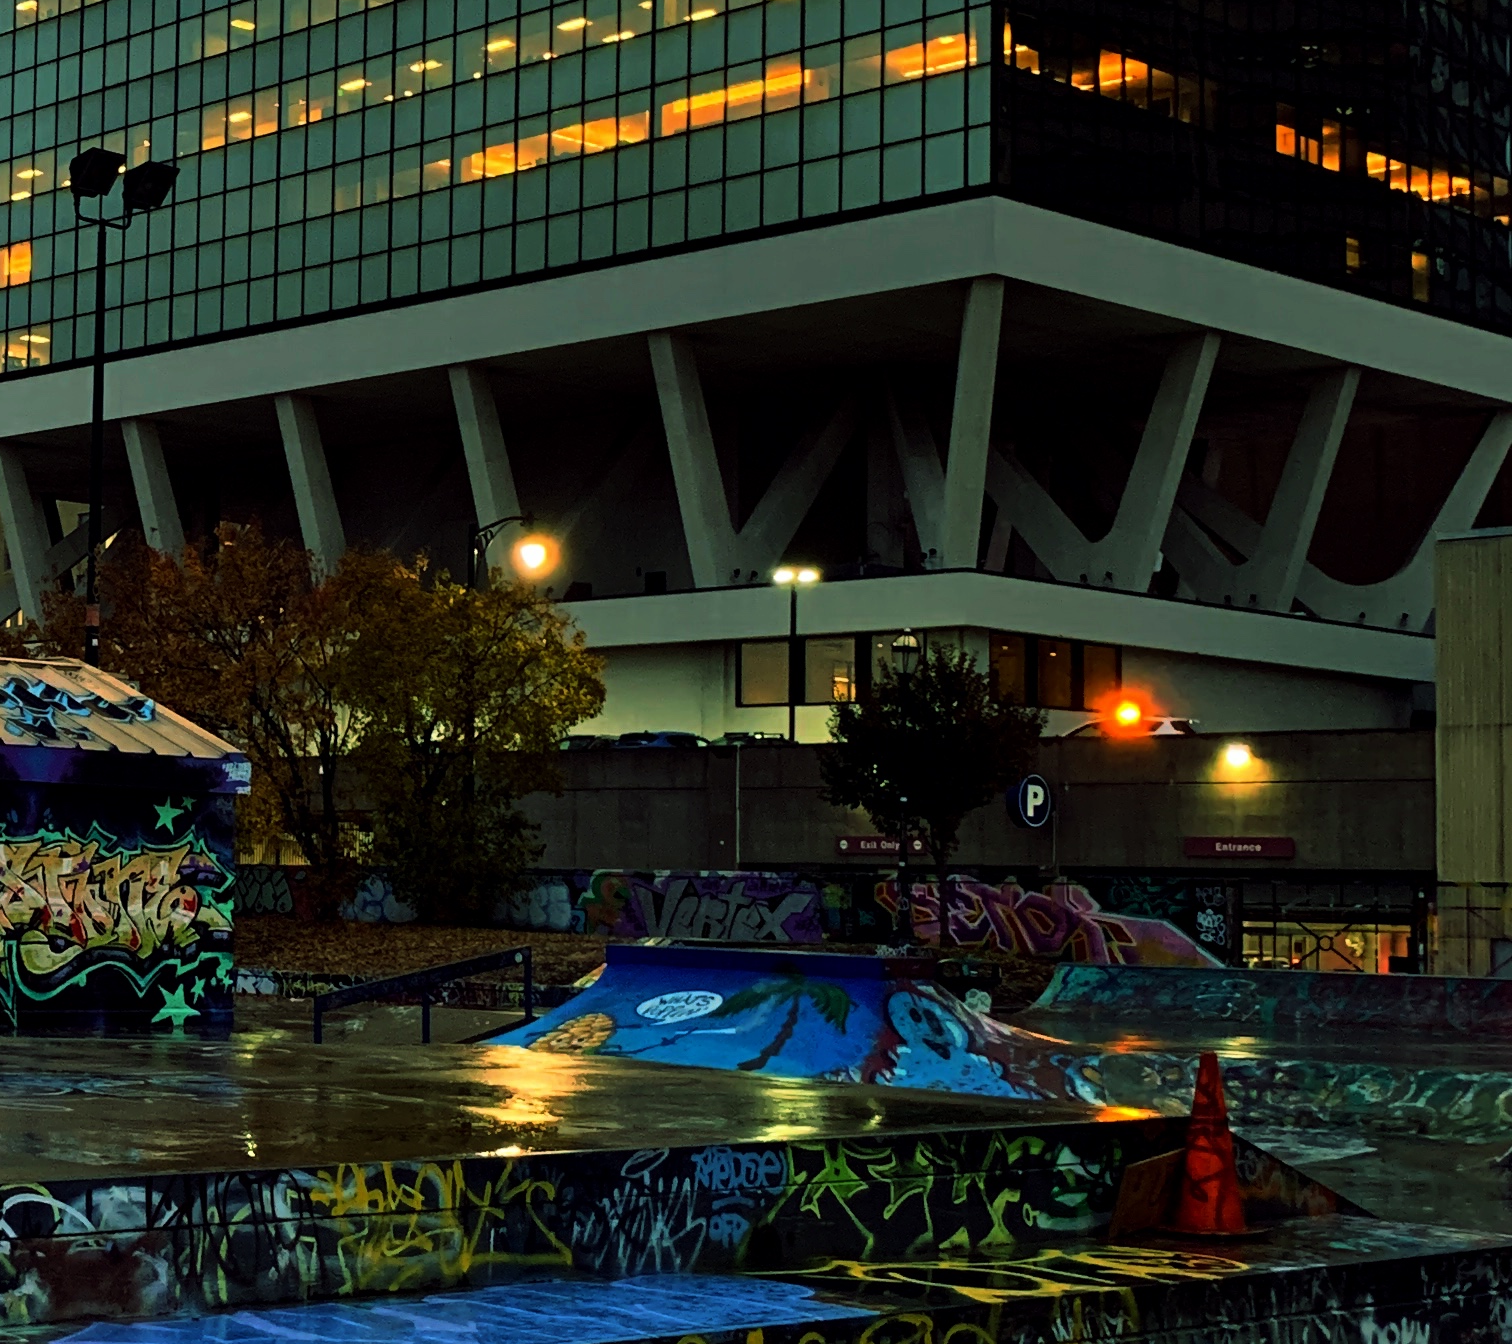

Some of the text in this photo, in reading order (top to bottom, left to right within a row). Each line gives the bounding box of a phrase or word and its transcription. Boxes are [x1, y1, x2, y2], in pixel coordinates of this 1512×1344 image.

[1026, 783, 1046, 818] P
[860, 840, 901, 851] Exit Only
[1215, 842, 1262, 852] Entrance
